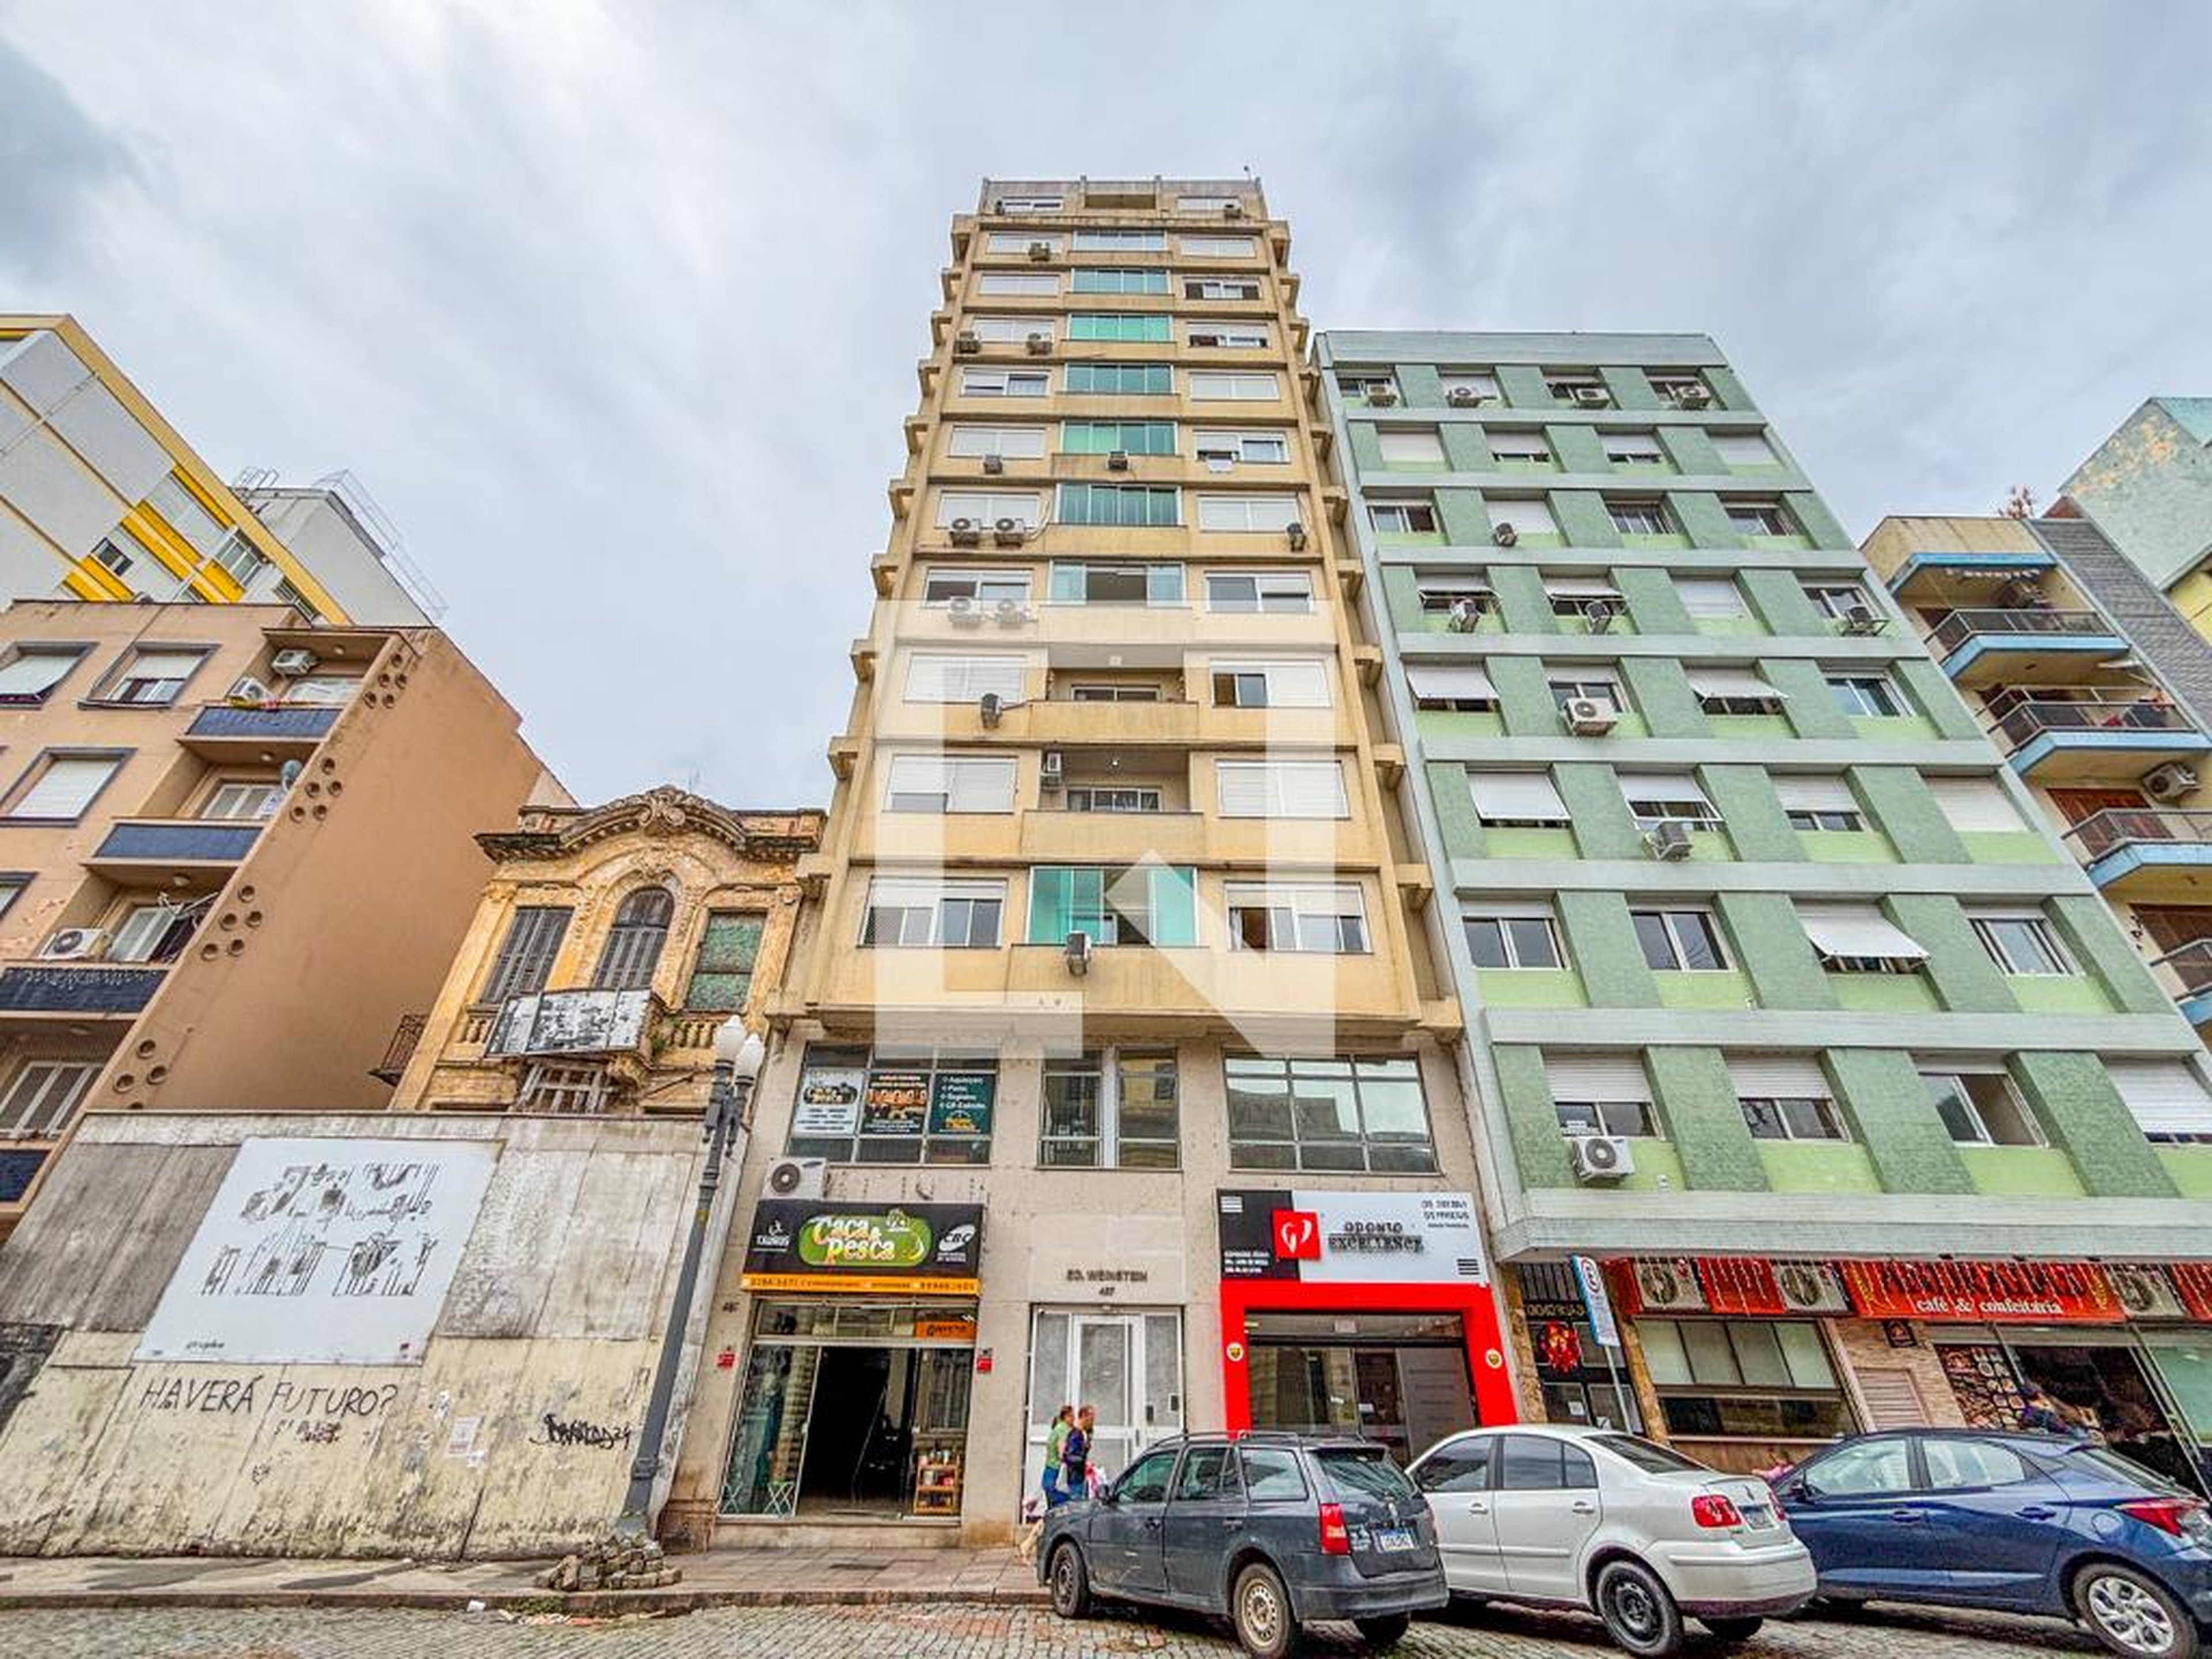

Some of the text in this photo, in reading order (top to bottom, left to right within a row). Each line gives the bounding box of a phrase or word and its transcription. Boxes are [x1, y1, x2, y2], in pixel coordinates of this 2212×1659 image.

[1344, 1222, 1403, 1234] ODONTO
[1916, 1298, 2063, 1313] café & confeitaria
[139, 1374, 398, 1416] HAVERÁ FUTURO?
